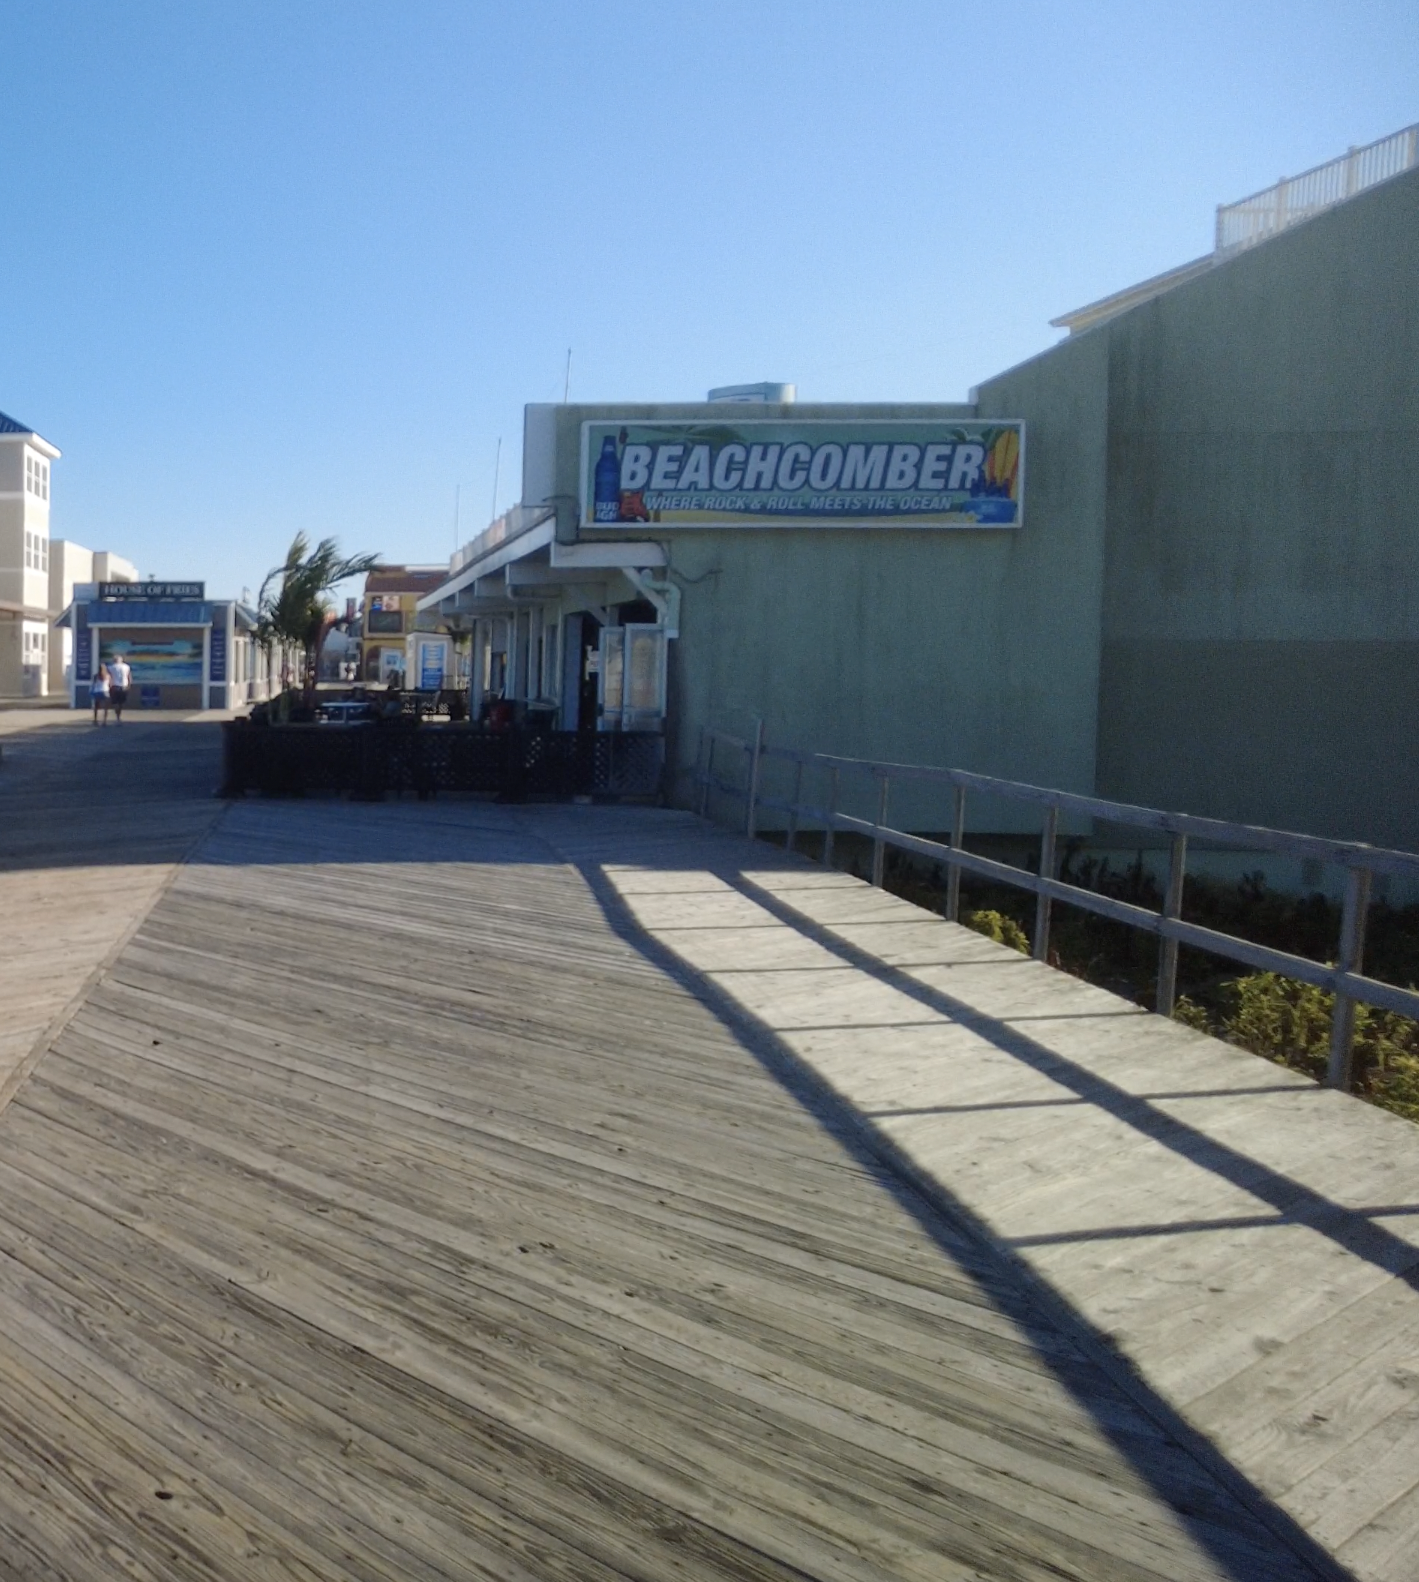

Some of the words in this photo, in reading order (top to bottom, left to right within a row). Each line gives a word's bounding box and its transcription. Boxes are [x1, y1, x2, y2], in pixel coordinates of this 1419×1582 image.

[619, 443, 985, 491] BEACHCOMBER
[646, 496, 700, 510] WHERE
[703, 496, 747, 510] ROCK
[749, 497, 763, 510] &
[766, 496, 806, 510] ROLL
[809, 496, 862, 510] MEETS
[867, 496, 895, 510] THE
[899, 496, 952, 510] OCEAN
[147, 584, 163, 596] OF
